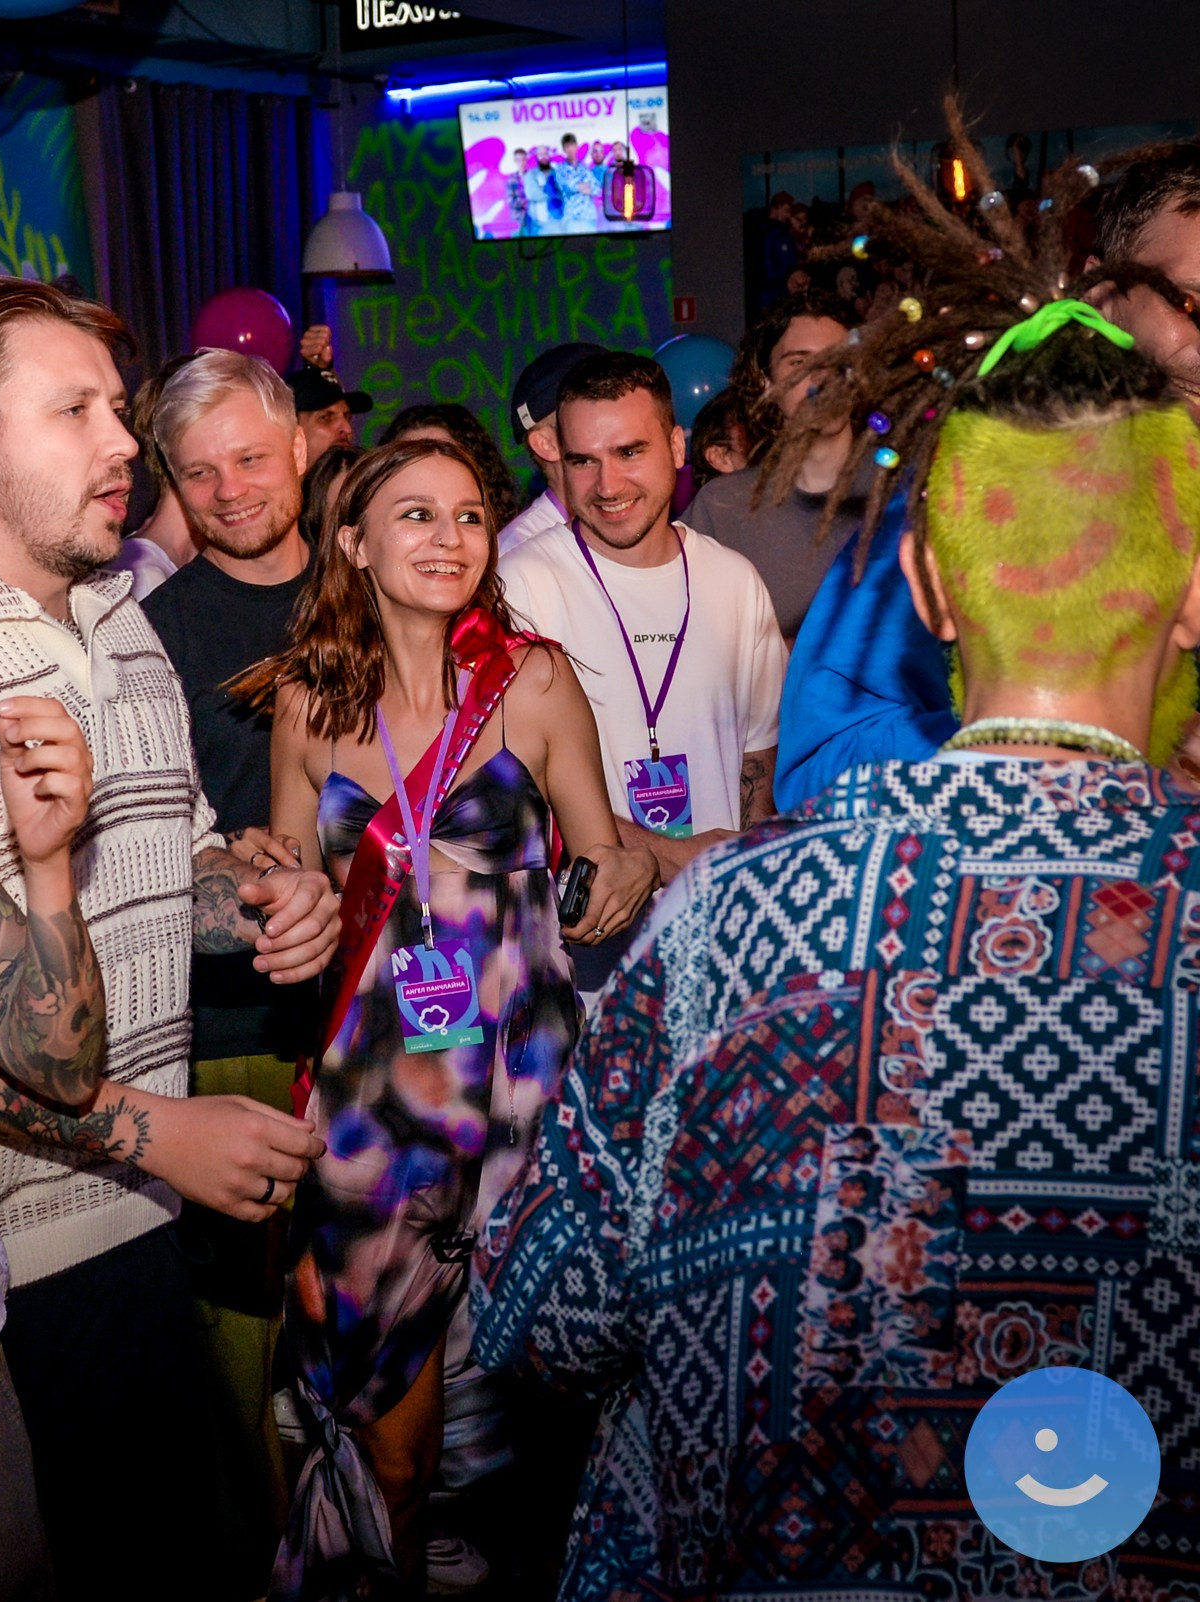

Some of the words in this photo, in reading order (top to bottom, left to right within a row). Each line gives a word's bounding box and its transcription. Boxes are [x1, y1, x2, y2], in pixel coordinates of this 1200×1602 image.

[512, 97, 616, 124] ЙОПШОУ
[633, 633, 685, 643] ДРУЖБ
[405, 987, 426, 996] АНГЕЛ
[426, 980, 466, 993] ПАНЧЛАЙНА
